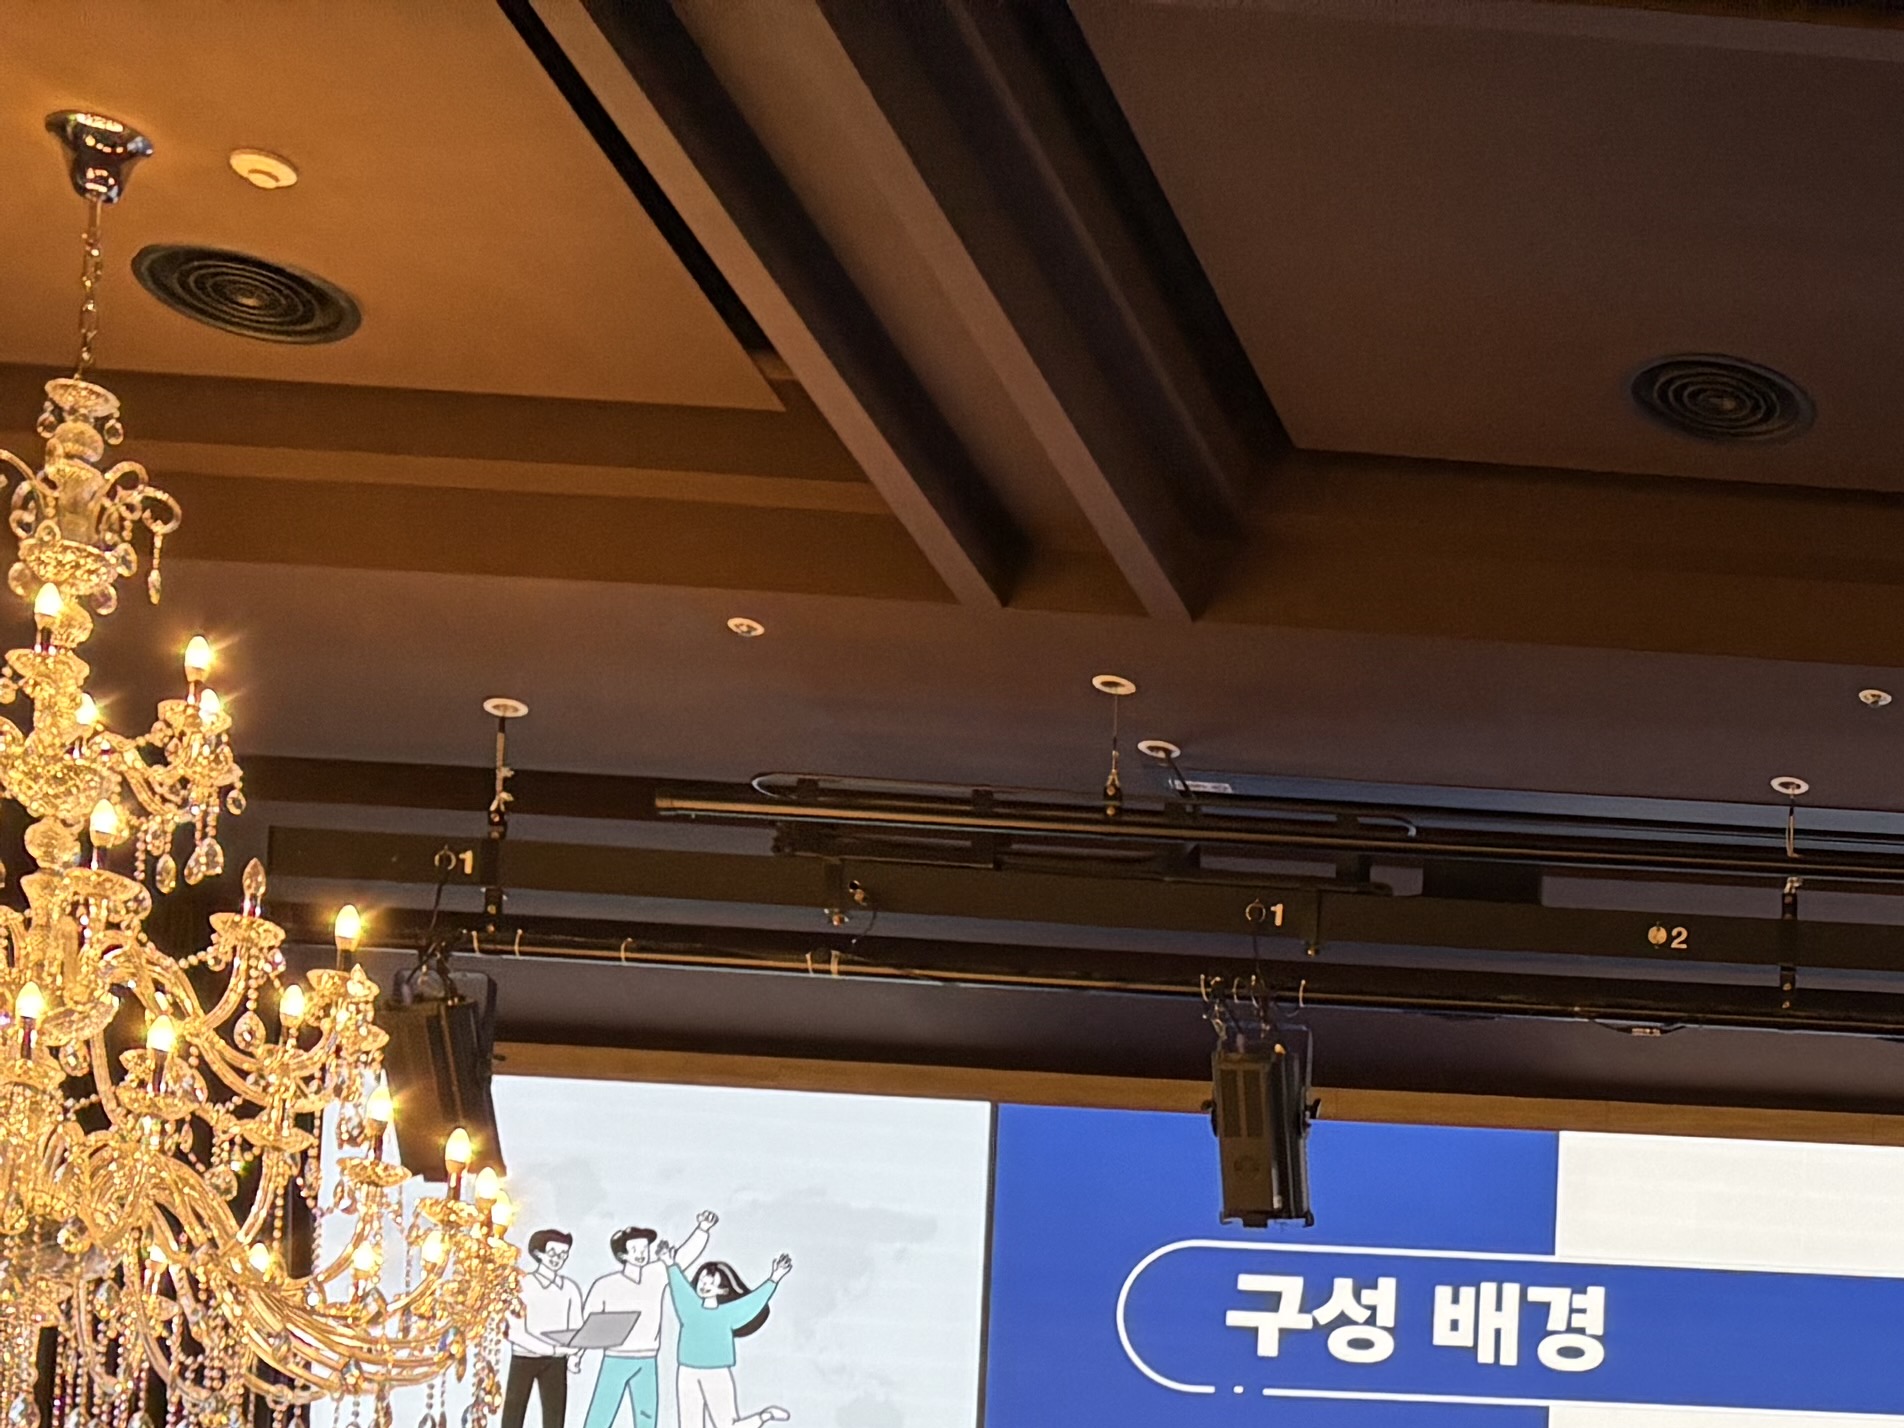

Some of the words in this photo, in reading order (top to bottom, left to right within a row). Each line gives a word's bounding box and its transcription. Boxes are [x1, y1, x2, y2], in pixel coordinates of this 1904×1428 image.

[459, 850, 473, 874] 1
[1271, 904, 1283, 926] 1
[1671, 927, 1687, 948] 2
[1226, 1274, 1396, 1363] 구성
[1433, 1282, 1605, 1371] 배경
